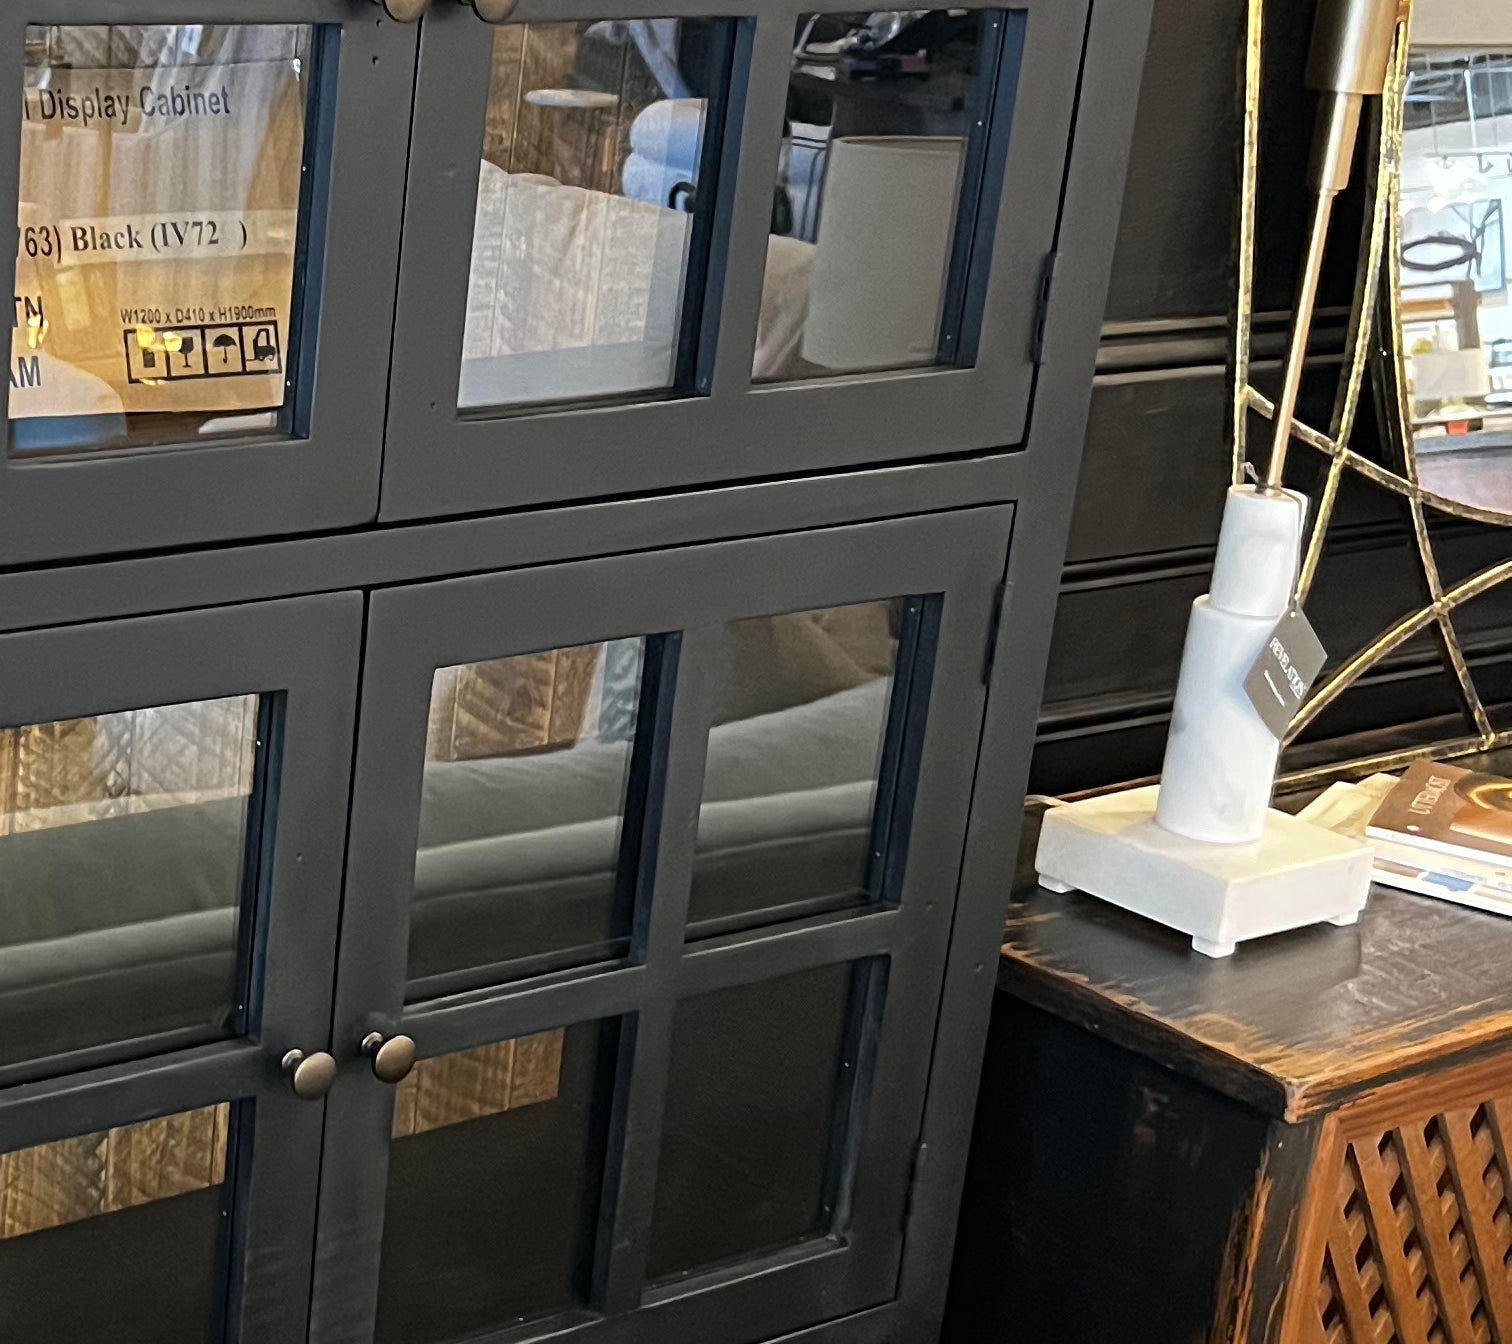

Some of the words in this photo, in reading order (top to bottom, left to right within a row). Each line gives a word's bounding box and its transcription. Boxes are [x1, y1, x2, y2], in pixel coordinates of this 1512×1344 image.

[38, 86, 130, 127] Display
[139, 85, 231, 118] Cabinet
[70, 223, 144, 252] Black
[119, 308, 163, 325] W1200
